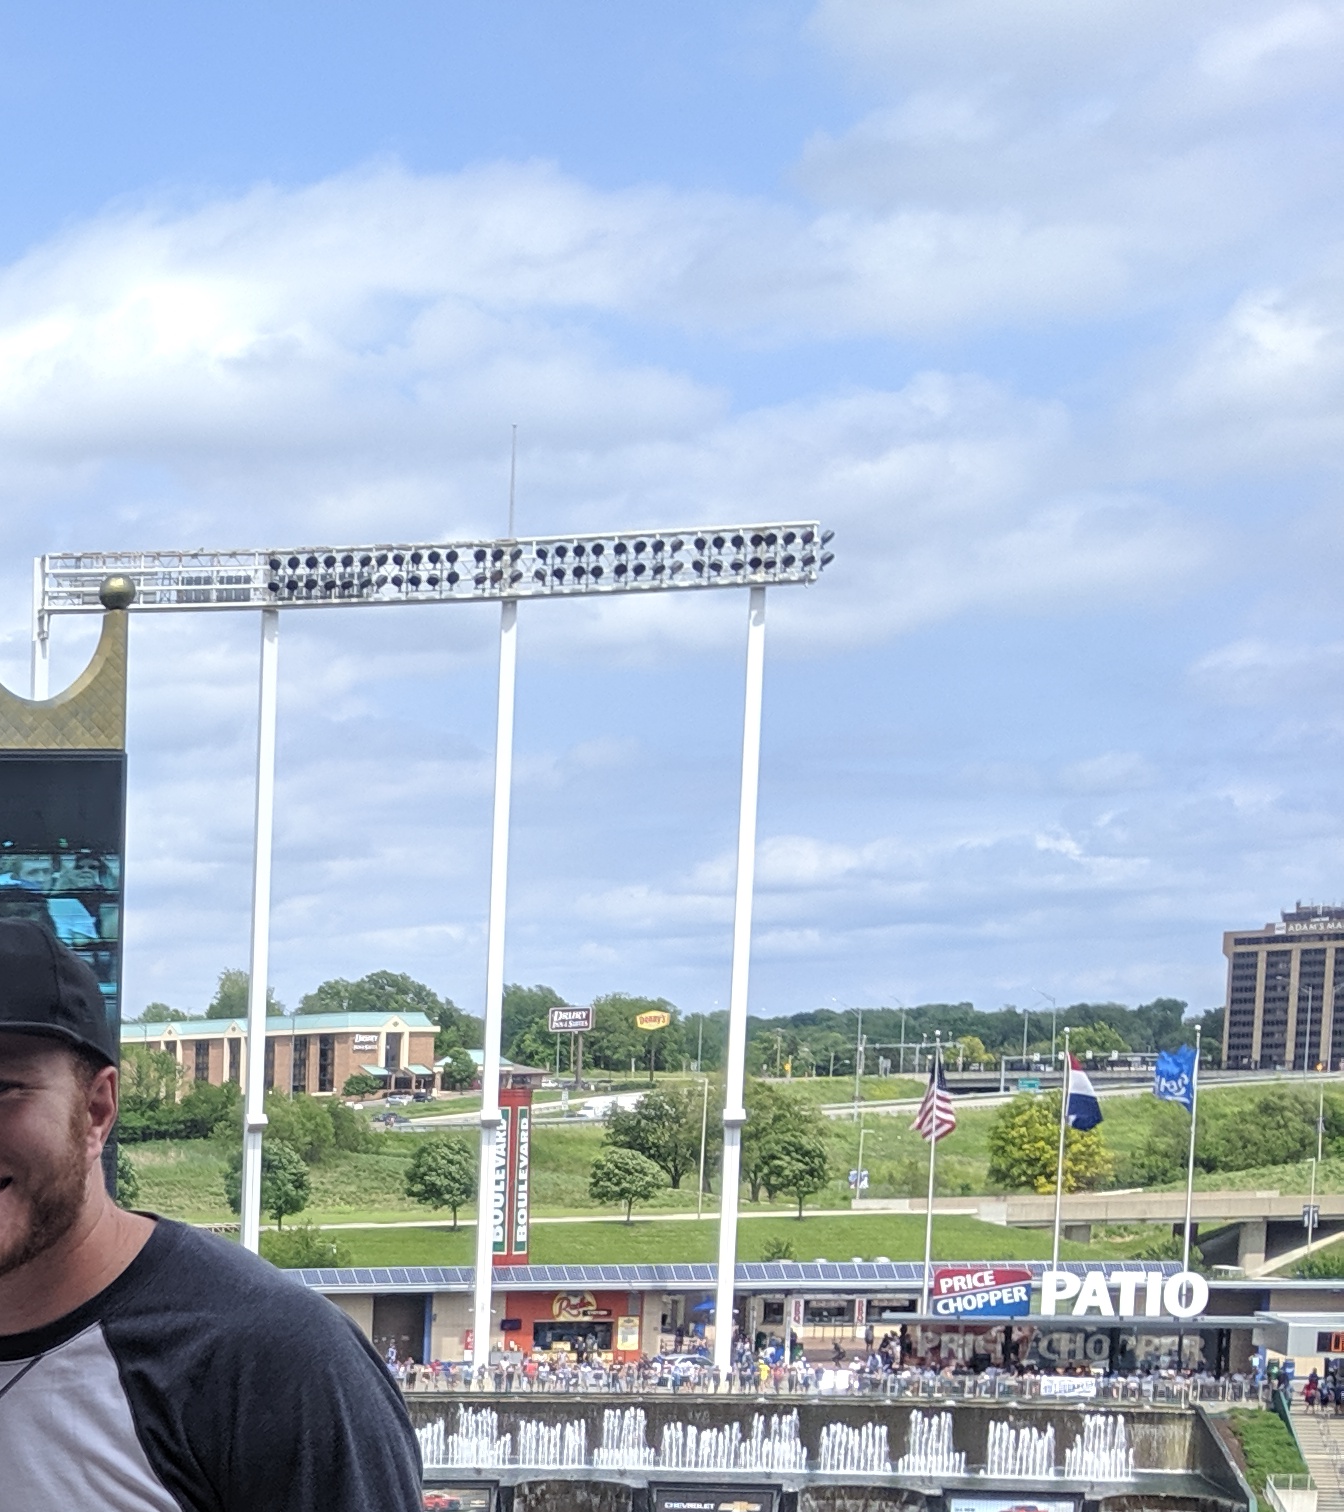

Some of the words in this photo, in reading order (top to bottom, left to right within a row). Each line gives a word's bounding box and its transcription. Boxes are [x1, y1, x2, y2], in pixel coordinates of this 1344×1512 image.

[639, 1014, 667, 1025] Denny's
[516, 1117, 529, 1242] BOULEVARD
[939, 1269, 996, 1295] PRICE
[1040, 1270, 1210, 1318] PATIO
[936, 1285, 1029, 1315] CHOPPER
